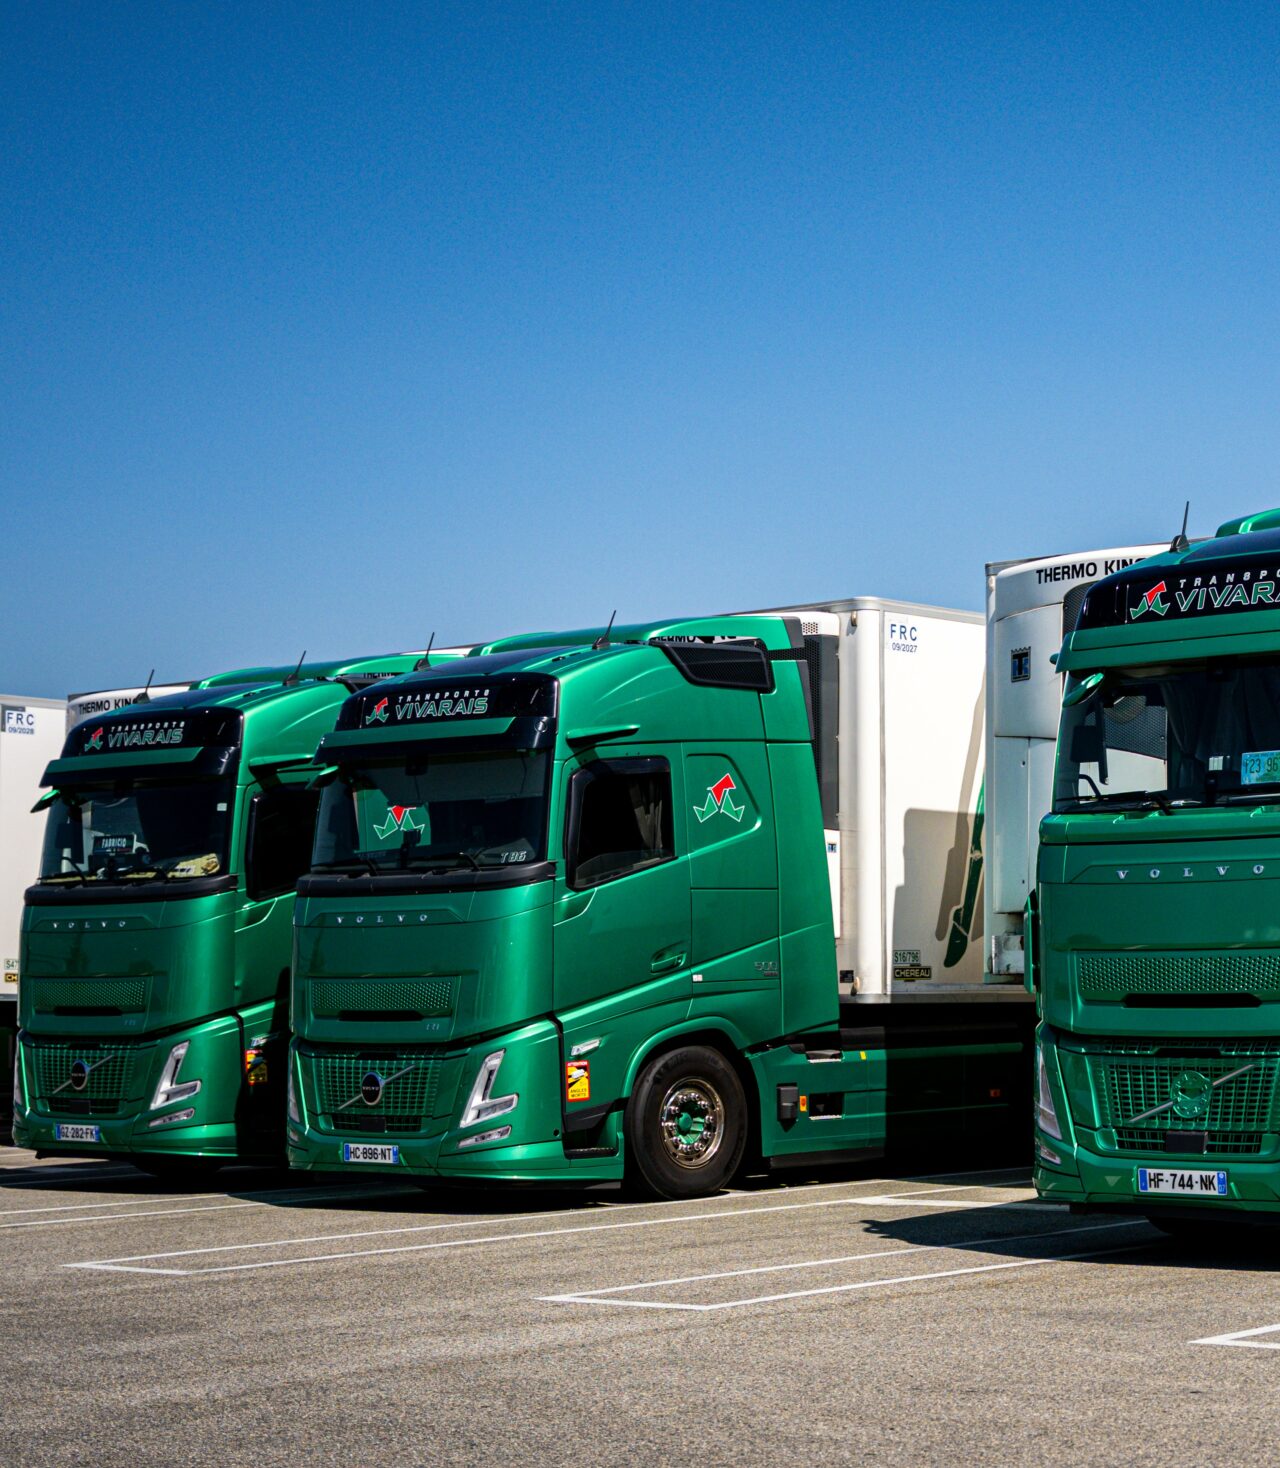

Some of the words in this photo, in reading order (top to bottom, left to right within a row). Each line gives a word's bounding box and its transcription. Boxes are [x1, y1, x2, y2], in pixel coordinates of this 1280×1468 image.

[1036, 562, 1097, 584] THERMO
[1104, 557, 1148, 576] KIN
[890, 623, 917, 641] FRC
[891, 642, 918, 653] 09/2027
[398, 688, 490, 703] TRANSPORTS
[78, 699, 111, 715] THERMO
[395, 697, 489, 720] VIVARAIS
[7, 711, 34, 726] FRC
[107, 728, 184, 748] VIVARAIS
[1116, 864, 1265, 880] VOLVO
[53, 920, 126, 929] VOLVO
[336, 914, 428, 924] VOLVO
[894, 969, 930, 978] CHEREAU
[350, 1146, 392, 1161] HC-896-NT
[1148, 1171, 1217, 1192] HF-744-NK
